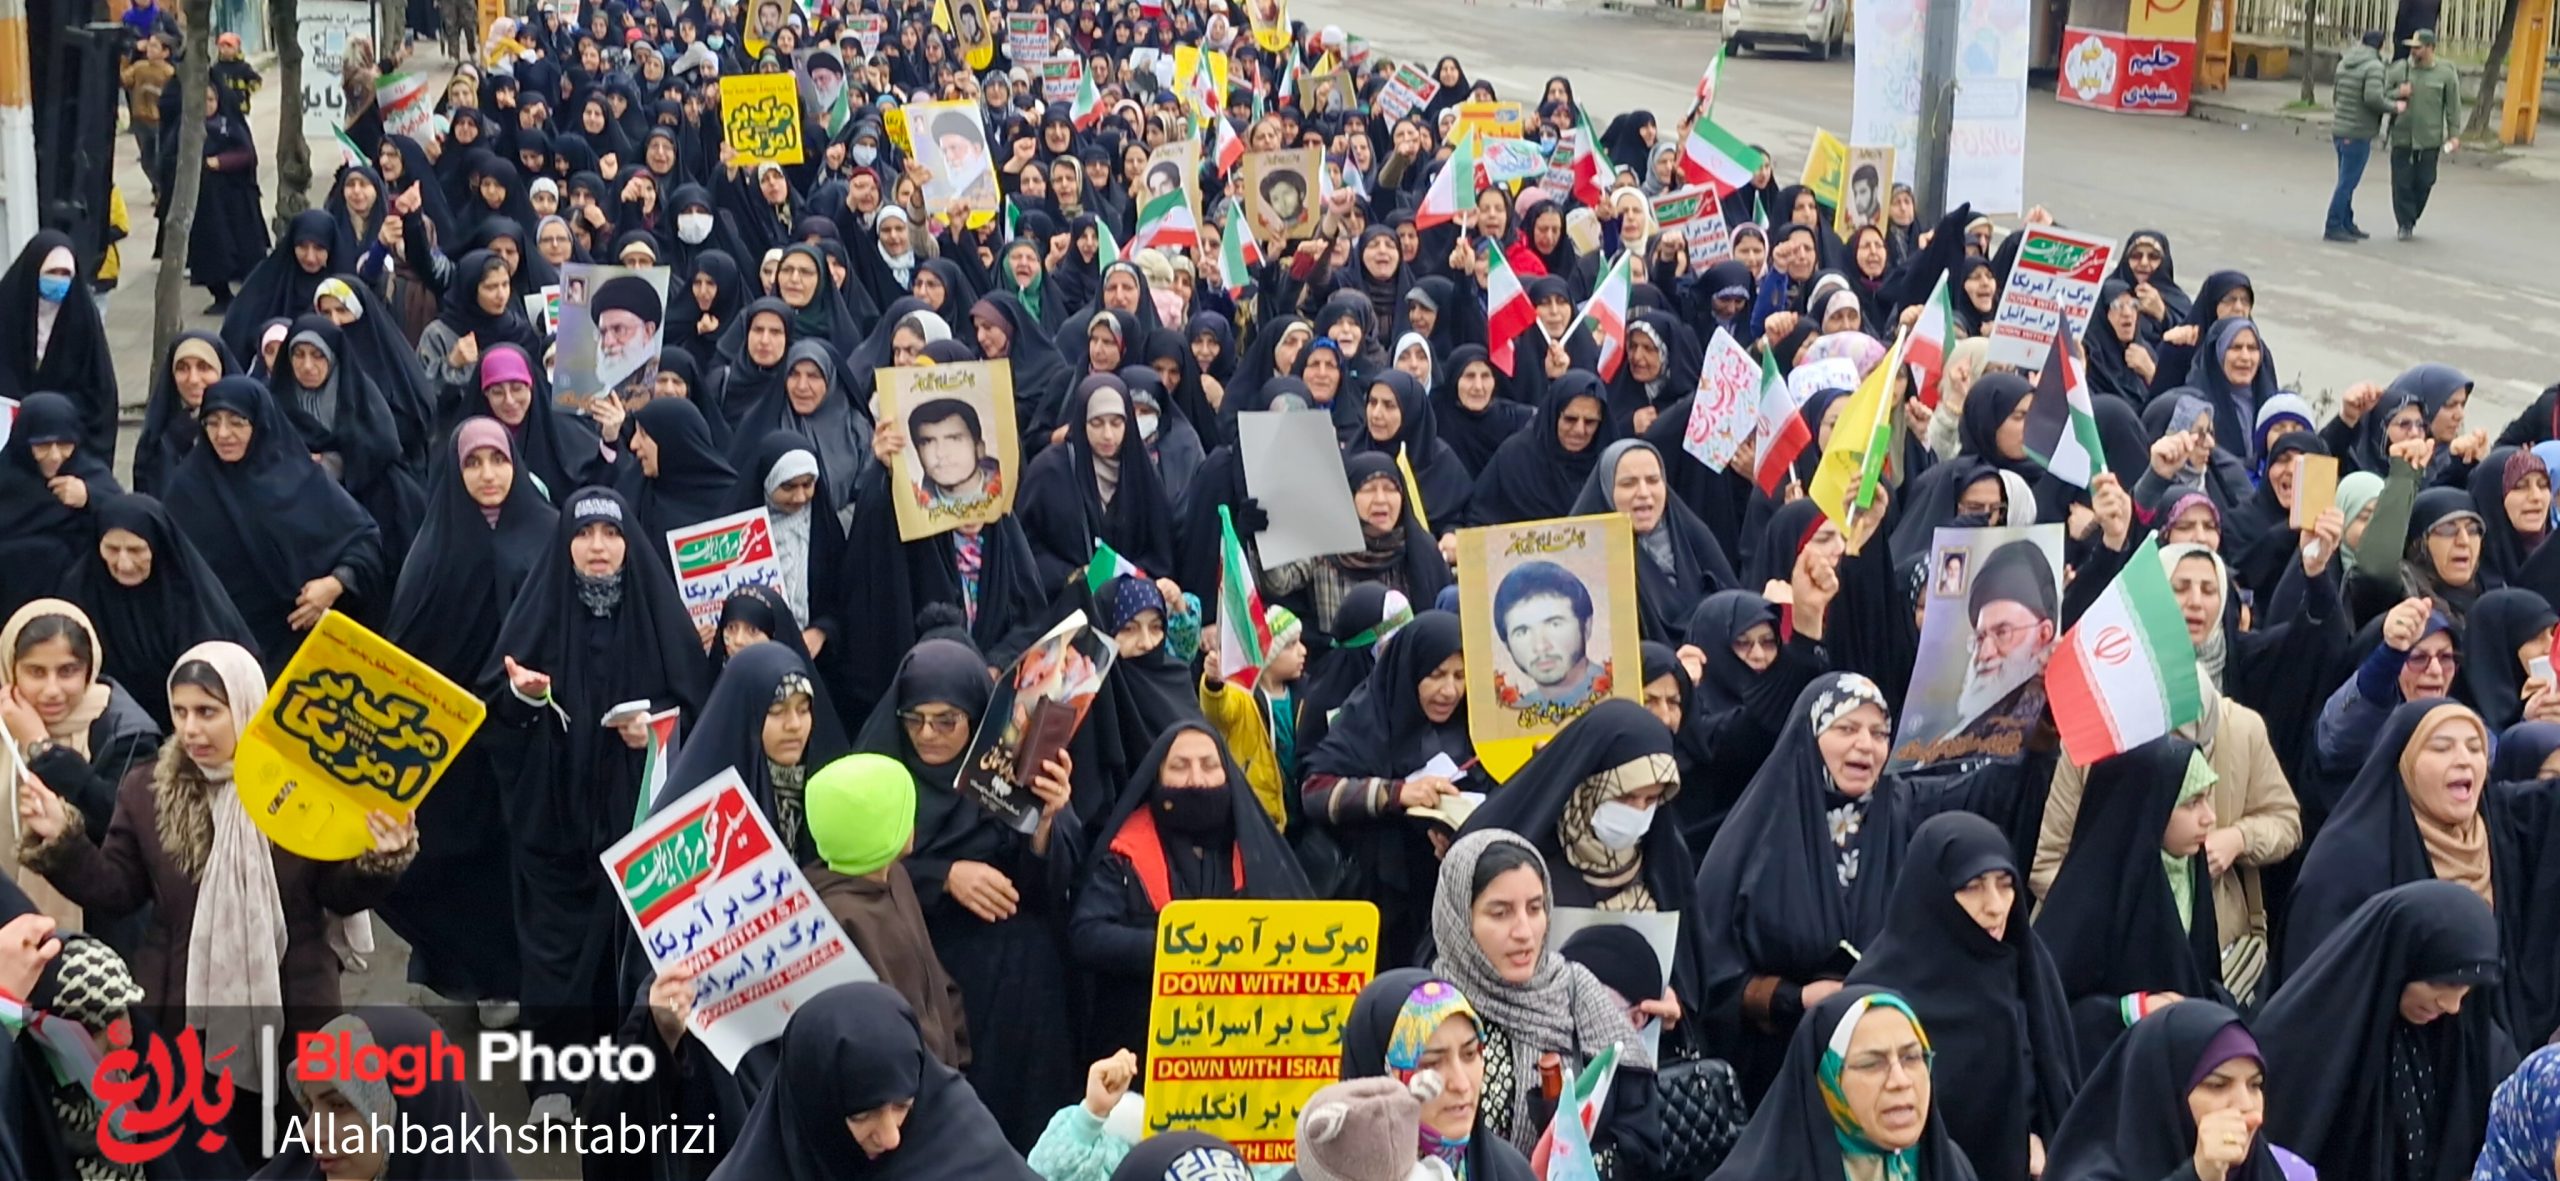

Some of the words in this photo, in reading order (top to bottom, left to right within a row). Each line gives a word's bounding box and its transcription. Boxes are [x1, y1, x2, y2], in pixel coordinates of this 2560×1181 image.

[2129, 44, 2179, 76] حلیم
[2122, 82, 2177, 106] مشهدی
[751, 97, 792, 127] مرگ
[2012, 271, 2053, 293] آمریکا
[2067, 287, 2093, 305] مرگ
[2042, 318, 2056, 331] بر
[684, 573, 731, 599] آمریکا
[748, 566, 778, 588] مرگ
[296, 673, 355, 711] بر
[341, 706, 378, 736] DOWN
[352, 688, 444, 760] مرگ
[281, 693, 424, 798] امریکا
[742, 867, 792, 902] مرگ
[649, 894, 715, 960] آمریکا
[713, 921, 760, 956] WITH
[762, 891, 810, 930] U.S.A
[722, 896, 744, 928] بر
[780, 917, 826, 950] مرگ
[1163, 916, 1268, 967] آمریکا
[1264, 931, 1296, 966] بر
[1302, 922, 1369, 966] مرگ
[762, 943, 780, 974] بر
[1163, 972, 1236, 994] DOWN
[1241, 972, 1299, 993] WITH
[1304, 972, 1362, 993] U.S.A
[1156, 1002, 1263, 1046] اسرائیل
[1265, 1014, 1294, 1047] بر
[1302, 1008, 1343, 1047] رگ
[1158, 1058, 1224, 1079] DOWN
[1228, 1058, 1281, 1077] WITH
[1286, 1057, 1340, 1076] ISRAE
[1149, 1091, 1248, 1131] انگلیس
[1254, 1099, 1281, 1131] بر
